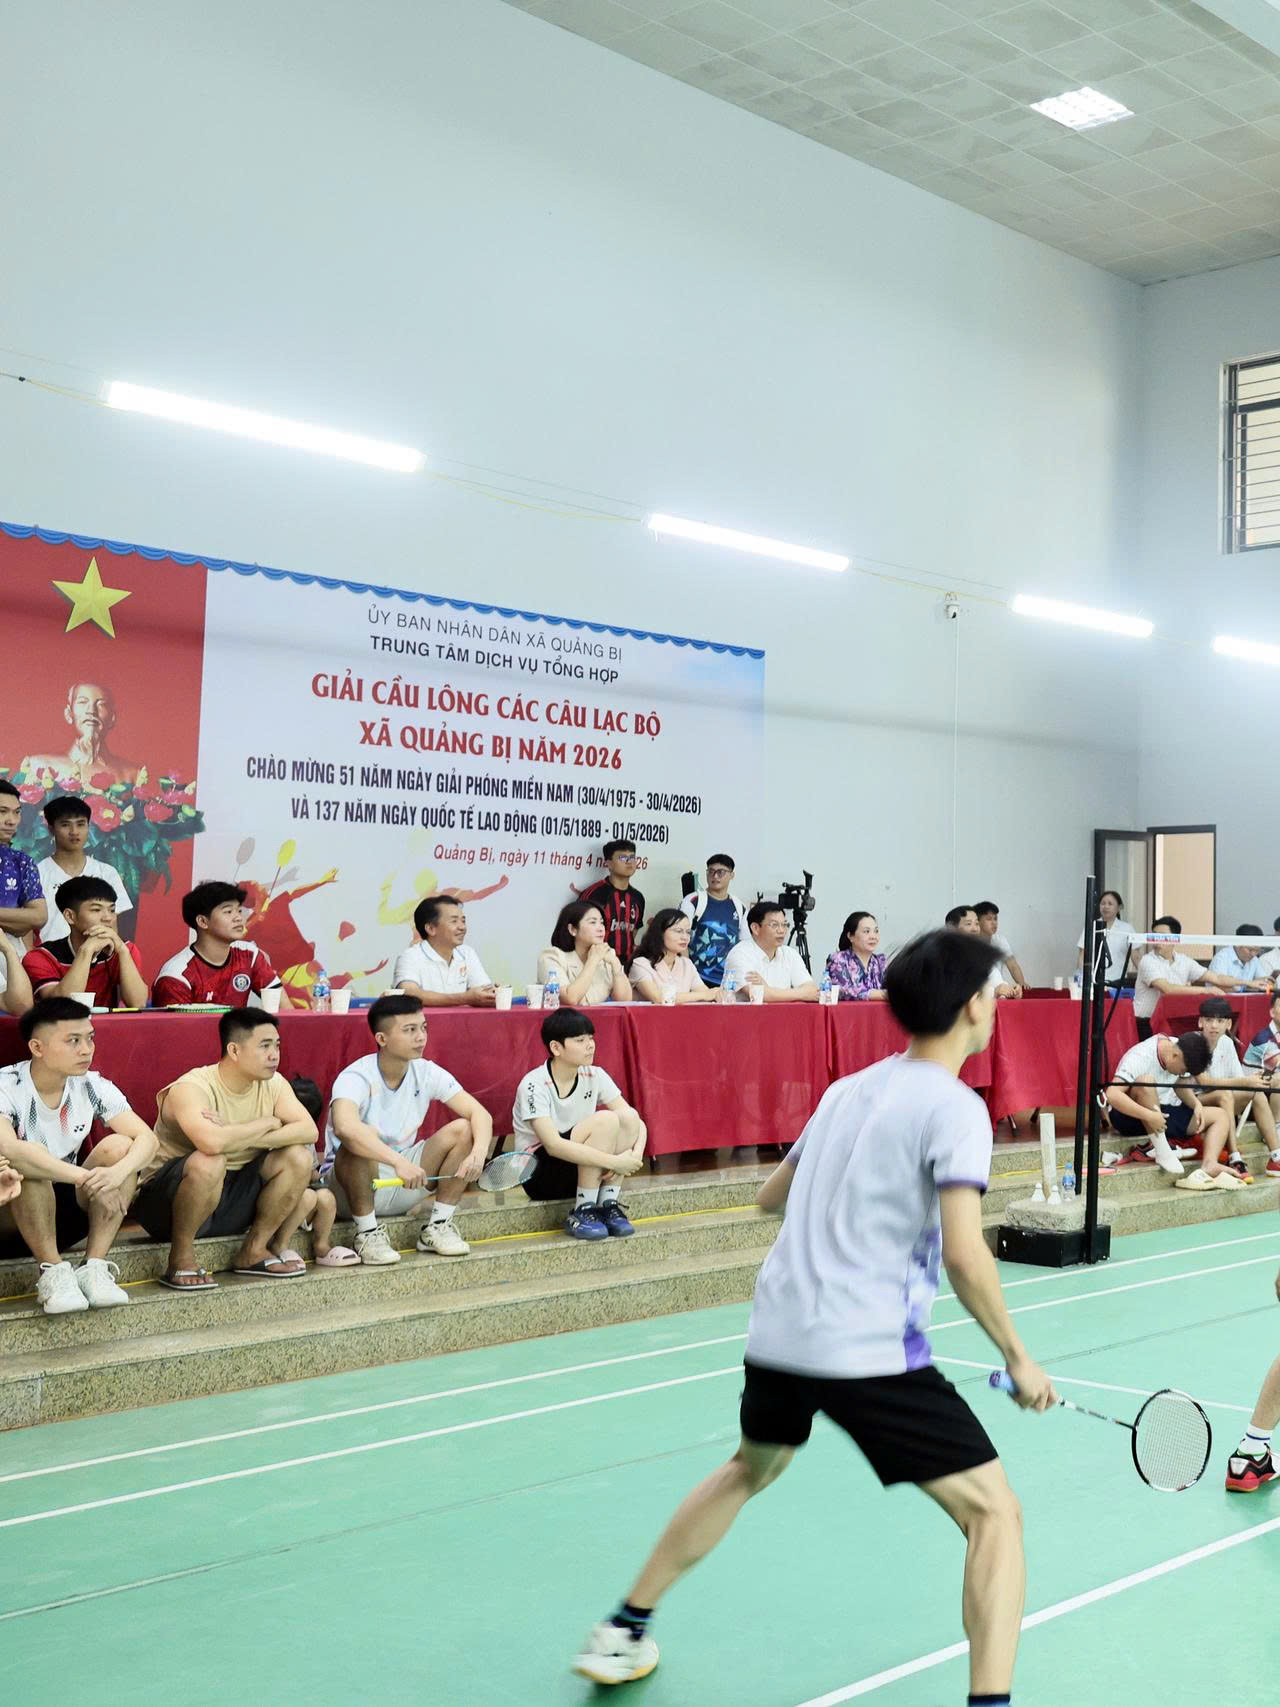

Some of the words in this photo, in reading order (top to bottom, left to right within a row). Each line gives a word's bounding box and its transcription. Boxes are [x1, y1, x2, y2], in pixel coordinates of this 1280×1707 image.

[368, 604, 390, 624] ỦY
[397, 613, 431, 631] BAN
[437, 620, 483, 639] NHÂN
[489, 626, 520, 646] DÂN
[526, 631, 546, 649] XÃ
[551, 635, 603, 658] QUẢNG
[609, 647, 622, 664] BỊ
[370, 635, 430, 656] TRUNG
[436, 643, 469, 662] TÂM
[475, 651, 512, 669] DỊCH
[519, 657, 538, 675] VỤ
[543, 655, 584, 679] TỔNG
[589, 668, 619, 685] HỢP
[311, 668, 364, 702] GIẢI
[371, 675, 420, 708] CẦU
[427, 684, 489, 716] LÔNG
[496, 693, 539, 722] CÁC
[546, 700, 587, 728] CÂU
[593, 708, 628, 735] LẠC
[634, 711, 661, 741] BỘ
[359, 717, 392, 747] XÃ
[400, 721, 484, 755] QUẢNG
[491, 735, 511, 763] BỊ
[519, 736, 566, 764] NĂM
[574, 744, 622, 770] 2026
[246, 754, 287, 780] CHÀO
[291, 757, 334, 784] MỪNG
[340, 765, 355, 786] 51
[361, 764, 392, 789] NĂM
[397, 767, 432, 791] NGÀY
[436, 768, 461, 795] GIẢI
[466, 773, 507, 798] PHÓNG
[547, 784, 574, 803] NAM
[578, 786, 636, 809] (30/4/1975
[647, 792, 701, 815] 30/4/2026)
[291, 794, 309, 820] VÀ
[315, 800, 340, 822] 137
[344, 799, 377, 823] NĂM
[381, 801, 416, 826] NGÀY
[421, 802, 455, 829] QUỐC
[460, 804, 474, 830] TẾ
[478, 812, 500, 832] LAO
[504, 810, 537, 837] ĐỘNG
[541, 815, 601, 838] (01/5/1889
[612, 821, 669, 844] 01/5/2026)
[434, 844, 475, 864] Quảng
[479, 848, 495, 865] Bị,
[499, 849, 529, 867] ngày
[534, 851, 545, 864] 11
[550, 850, 582, 870] tháng
[586, 854, 592, 867] 4
